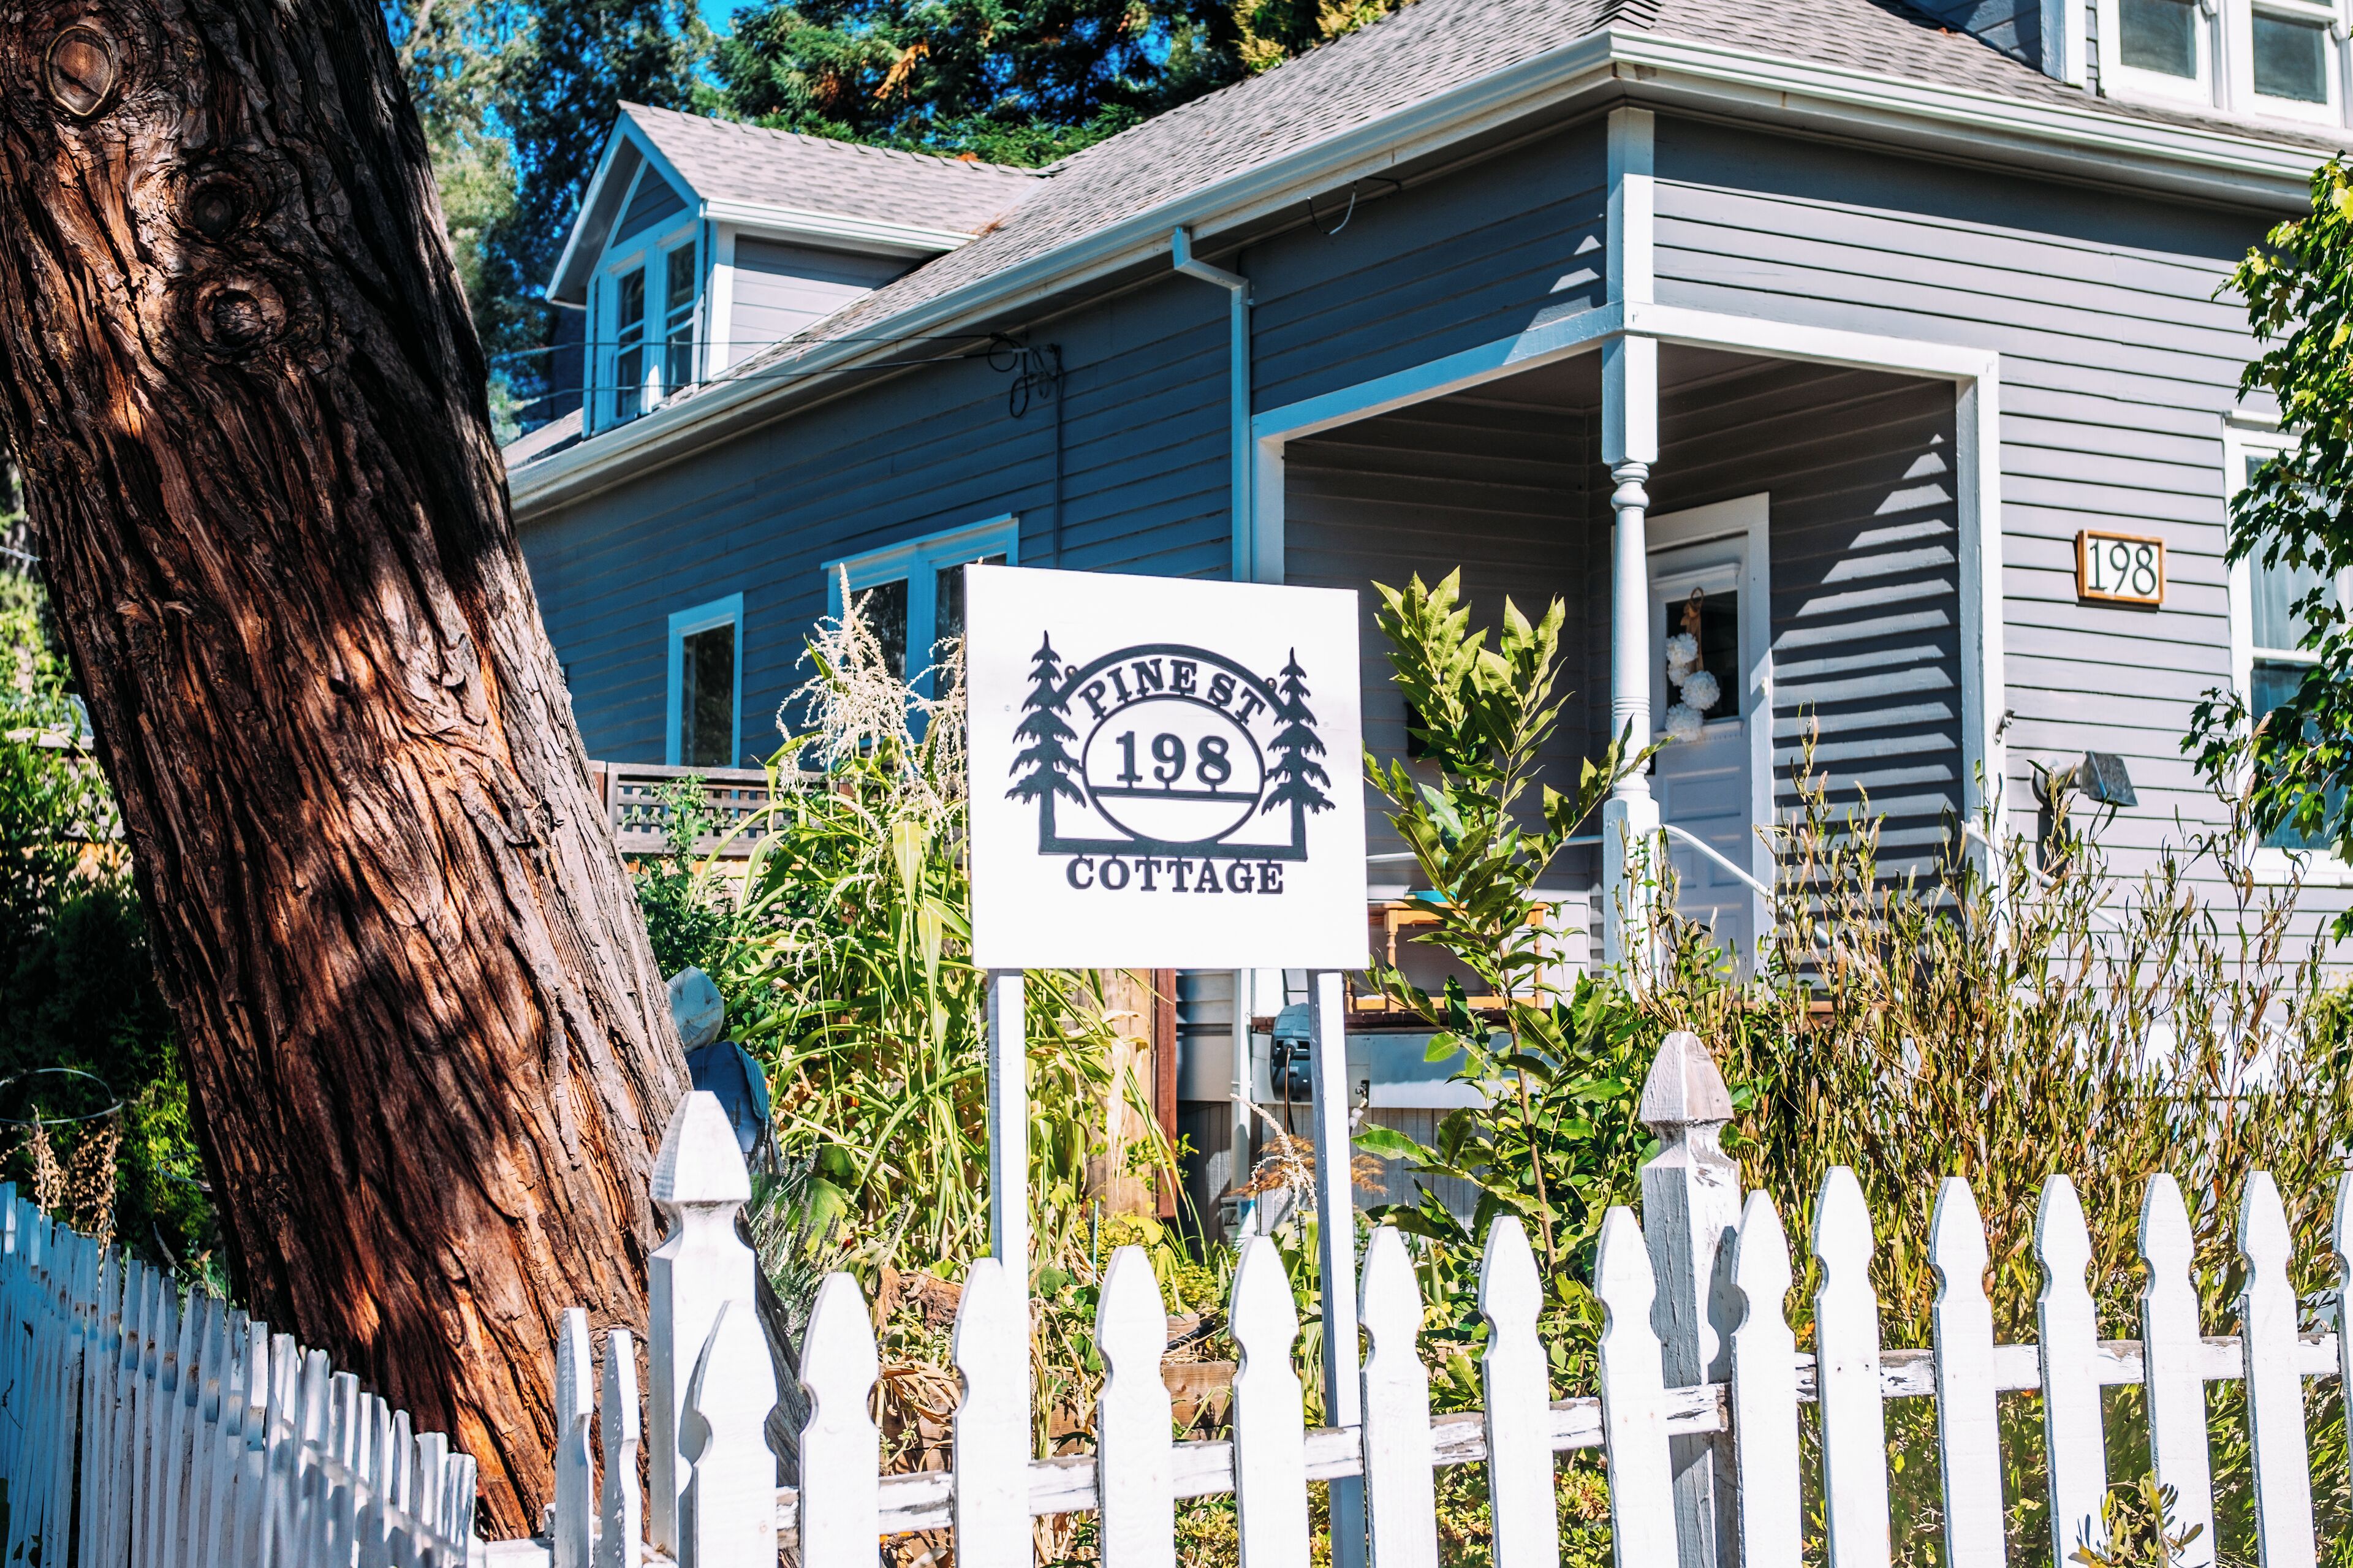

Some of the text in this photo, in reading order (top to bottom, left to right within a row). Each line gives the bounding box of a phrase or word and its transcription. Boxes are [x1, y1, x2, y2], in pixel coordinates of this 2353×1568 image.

[2088, 540, 2156, 595] 198
[1078, 659, 1266, 724] PINE ST
[1116, 731, 1232, 785] 198
[1067, 857, 1283, 894] COTTAGE
